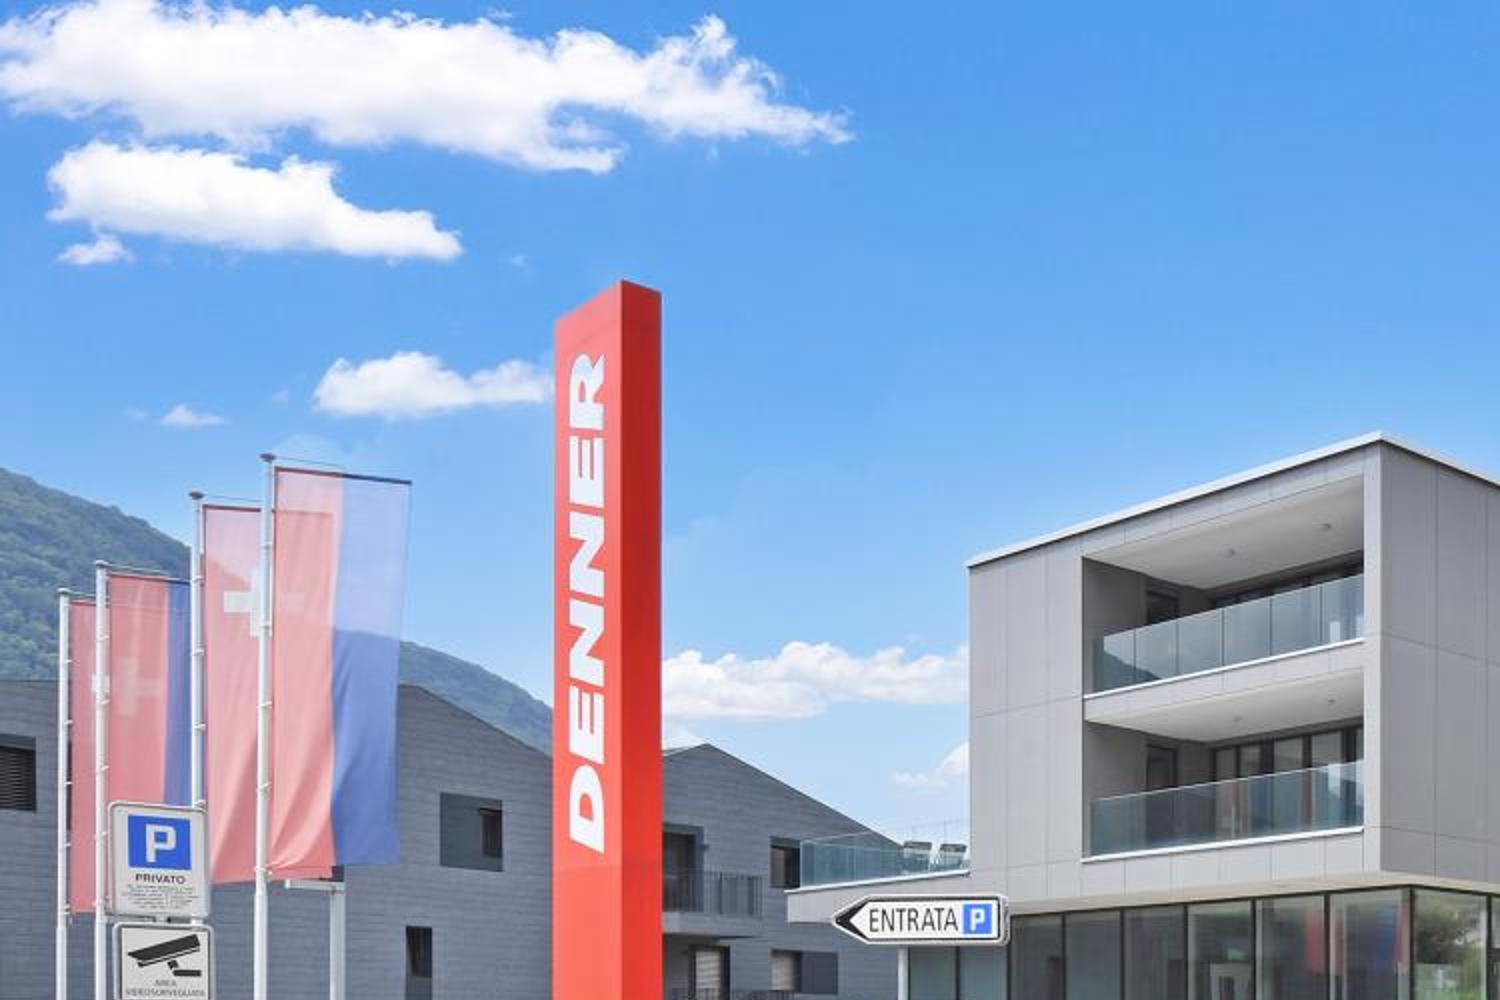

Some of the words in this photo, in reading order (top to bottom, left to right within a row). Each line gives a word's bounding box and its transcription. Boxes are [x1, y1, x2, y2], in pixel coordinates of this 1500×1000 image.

[569, 353, 604, 853] DENNER
[145, 823, 176, 863] P
[135, 873, 186, 884] PRIVATO
[869, 908, 958, 932] ENTRATA
[970, 909, 986, 932] P
